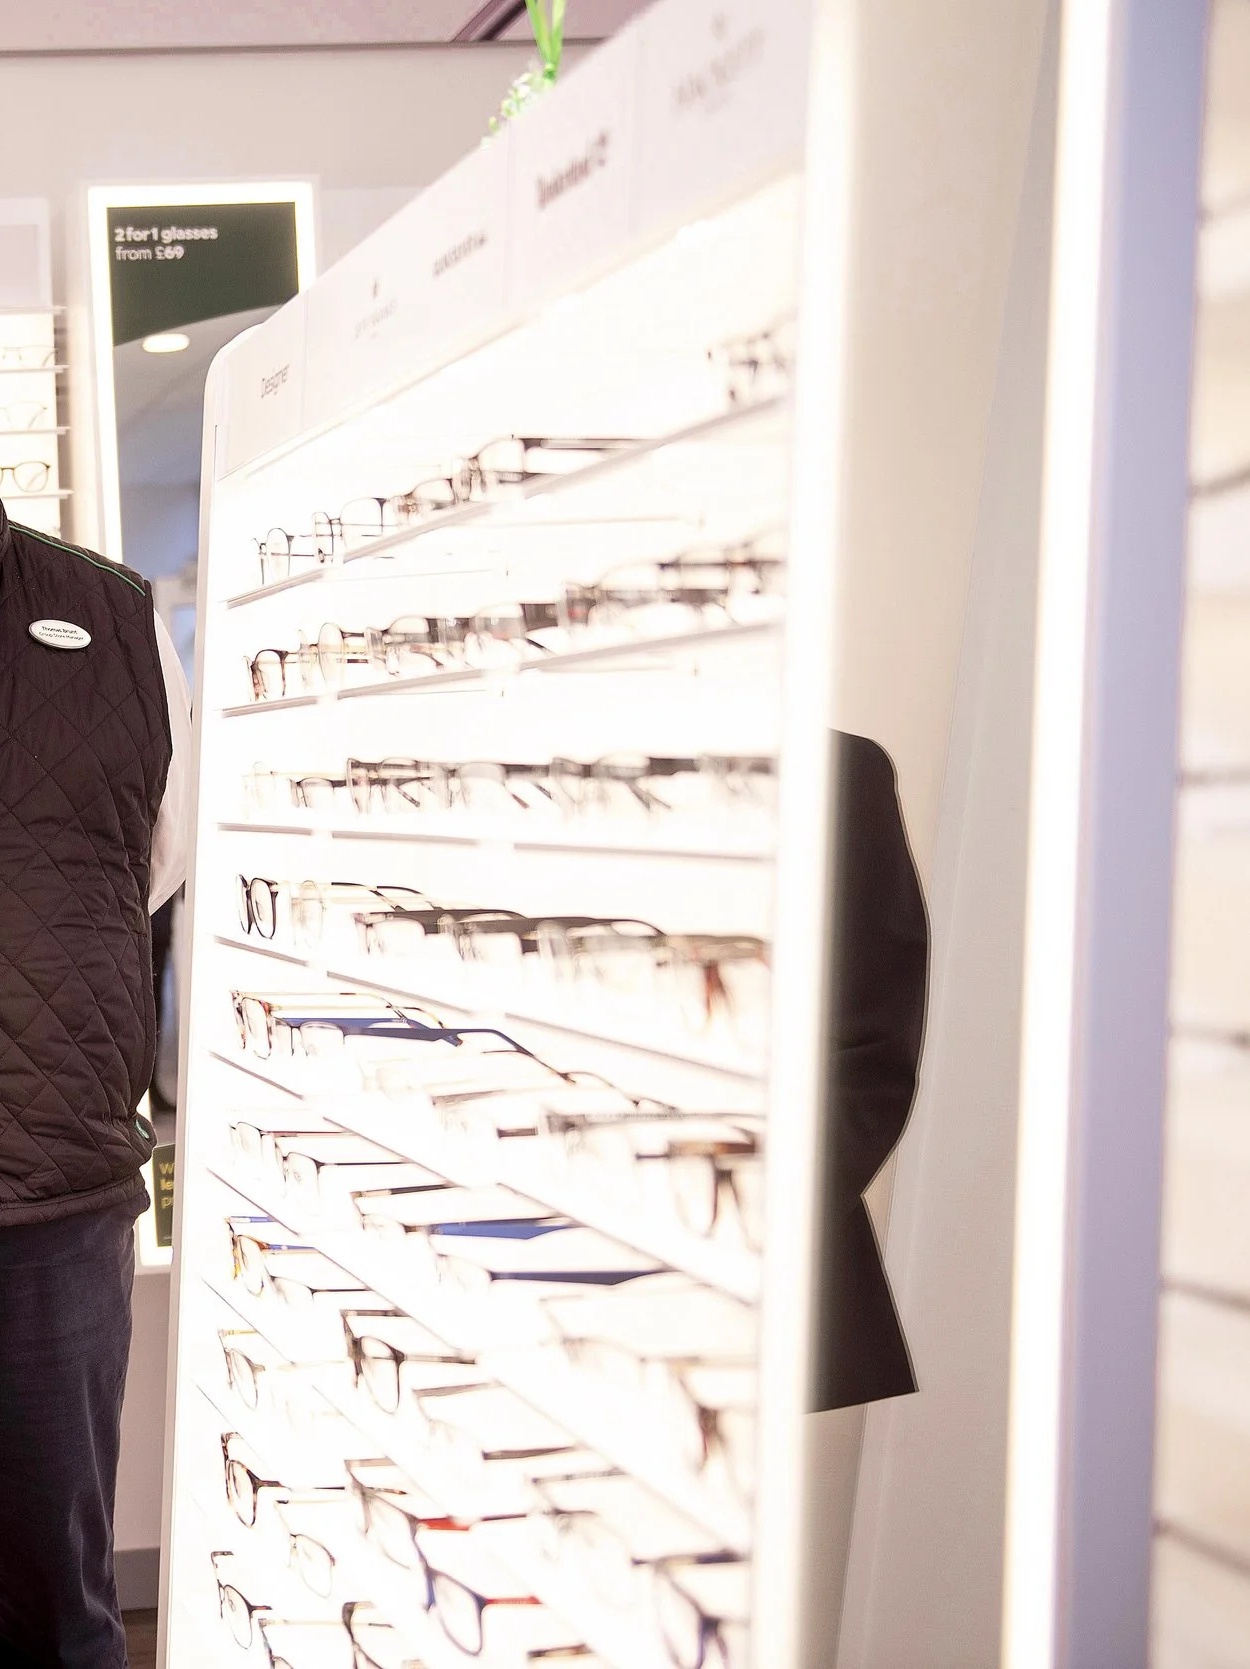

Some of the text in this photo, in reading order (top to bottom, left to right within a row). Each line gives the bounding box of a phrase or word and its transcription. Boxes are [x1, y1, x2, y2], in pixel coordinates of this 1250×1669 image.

[160, 226, 218, 244] glasses
[115, 245, 185, 261] from £69
